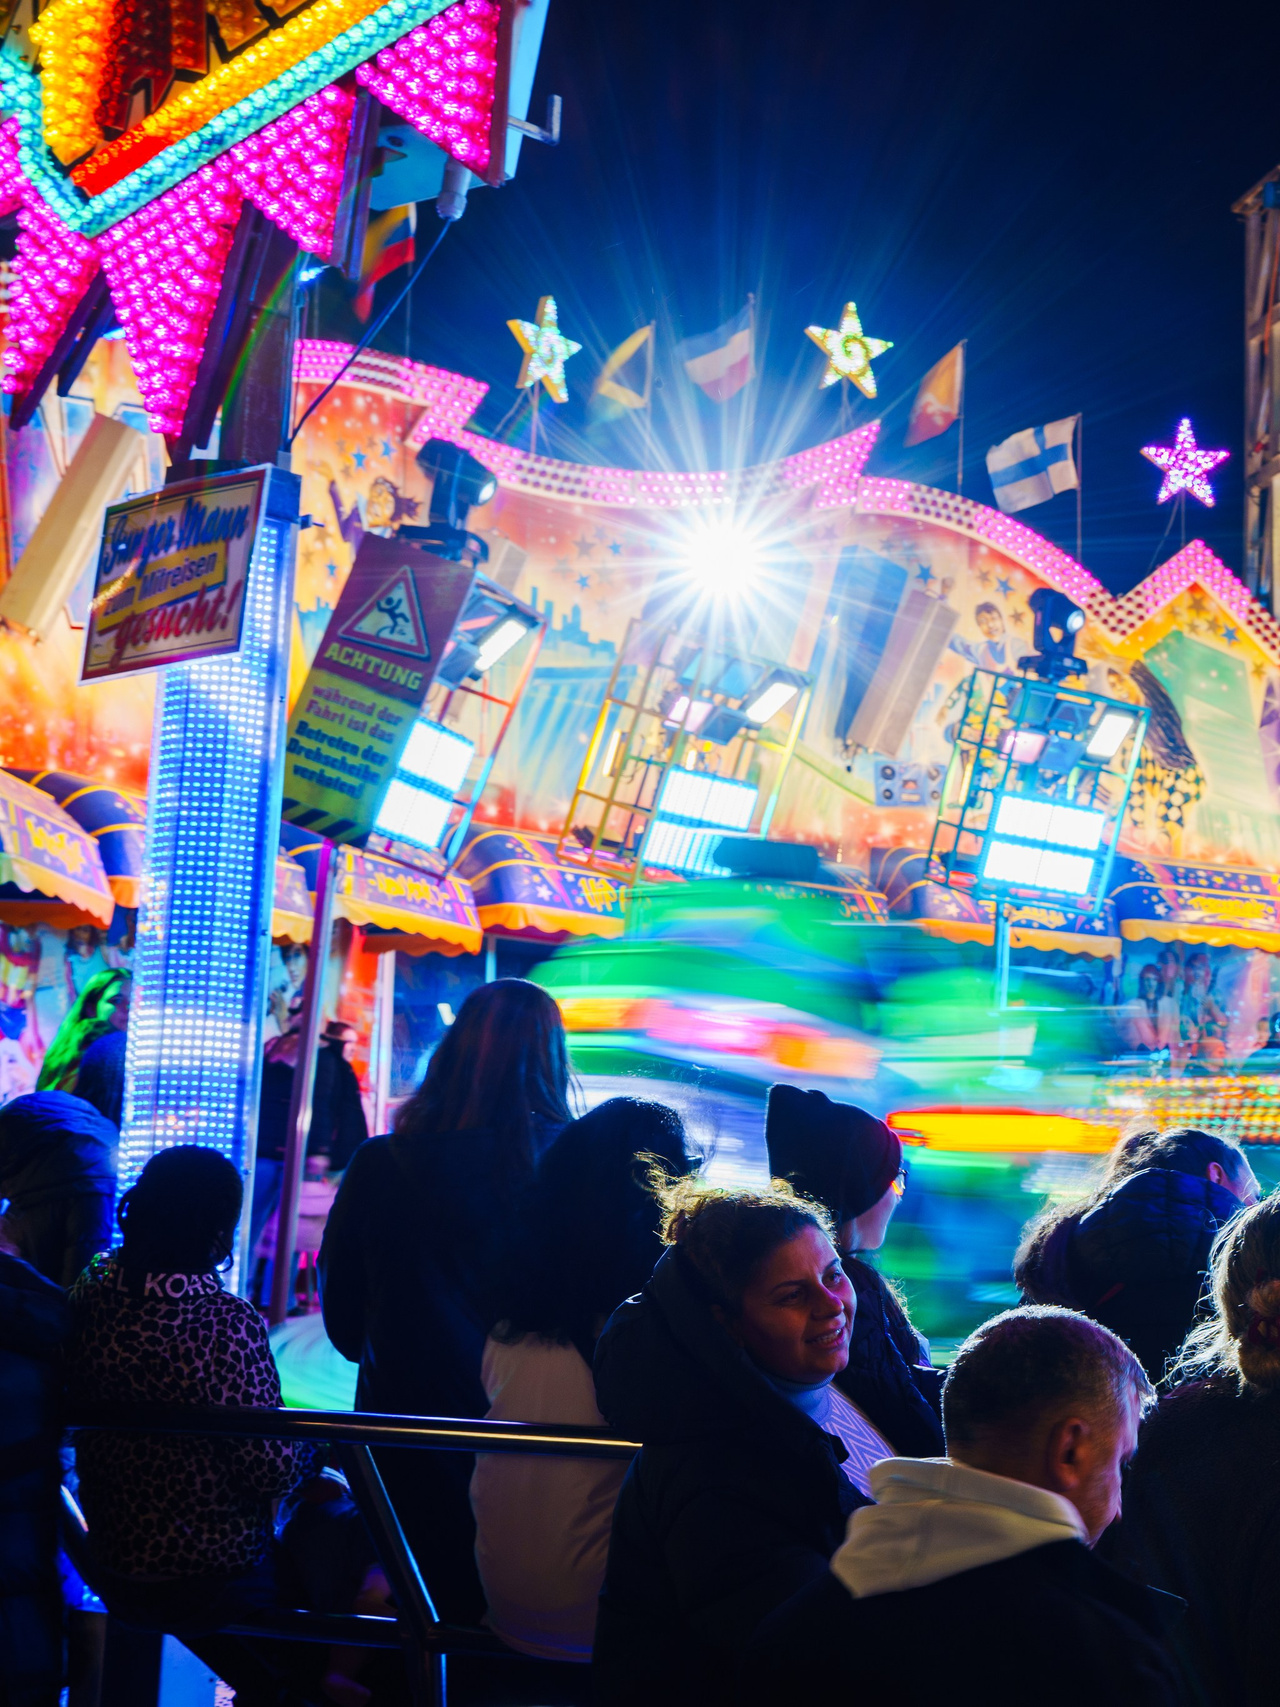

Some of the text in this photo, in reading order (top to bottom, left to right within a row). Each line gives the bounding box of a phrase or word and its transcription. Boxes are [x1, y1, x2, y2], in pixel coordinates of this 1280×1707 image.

[177, 496, 251, 549] Mann
[139, 551, 218, 601] Mitreisen
[109, 579, 244, 669] gesucht!
[323, 641, 424, 691] ACHTUNG
[304, 698, 396, 744] Fahrt ist das
[311, 684, 403, 727] während der
[287, 738, 382, 785] Drehscheibe
[294, 720, 389, 767] Betreten der
[292, 763, 364, 800] verboten!
